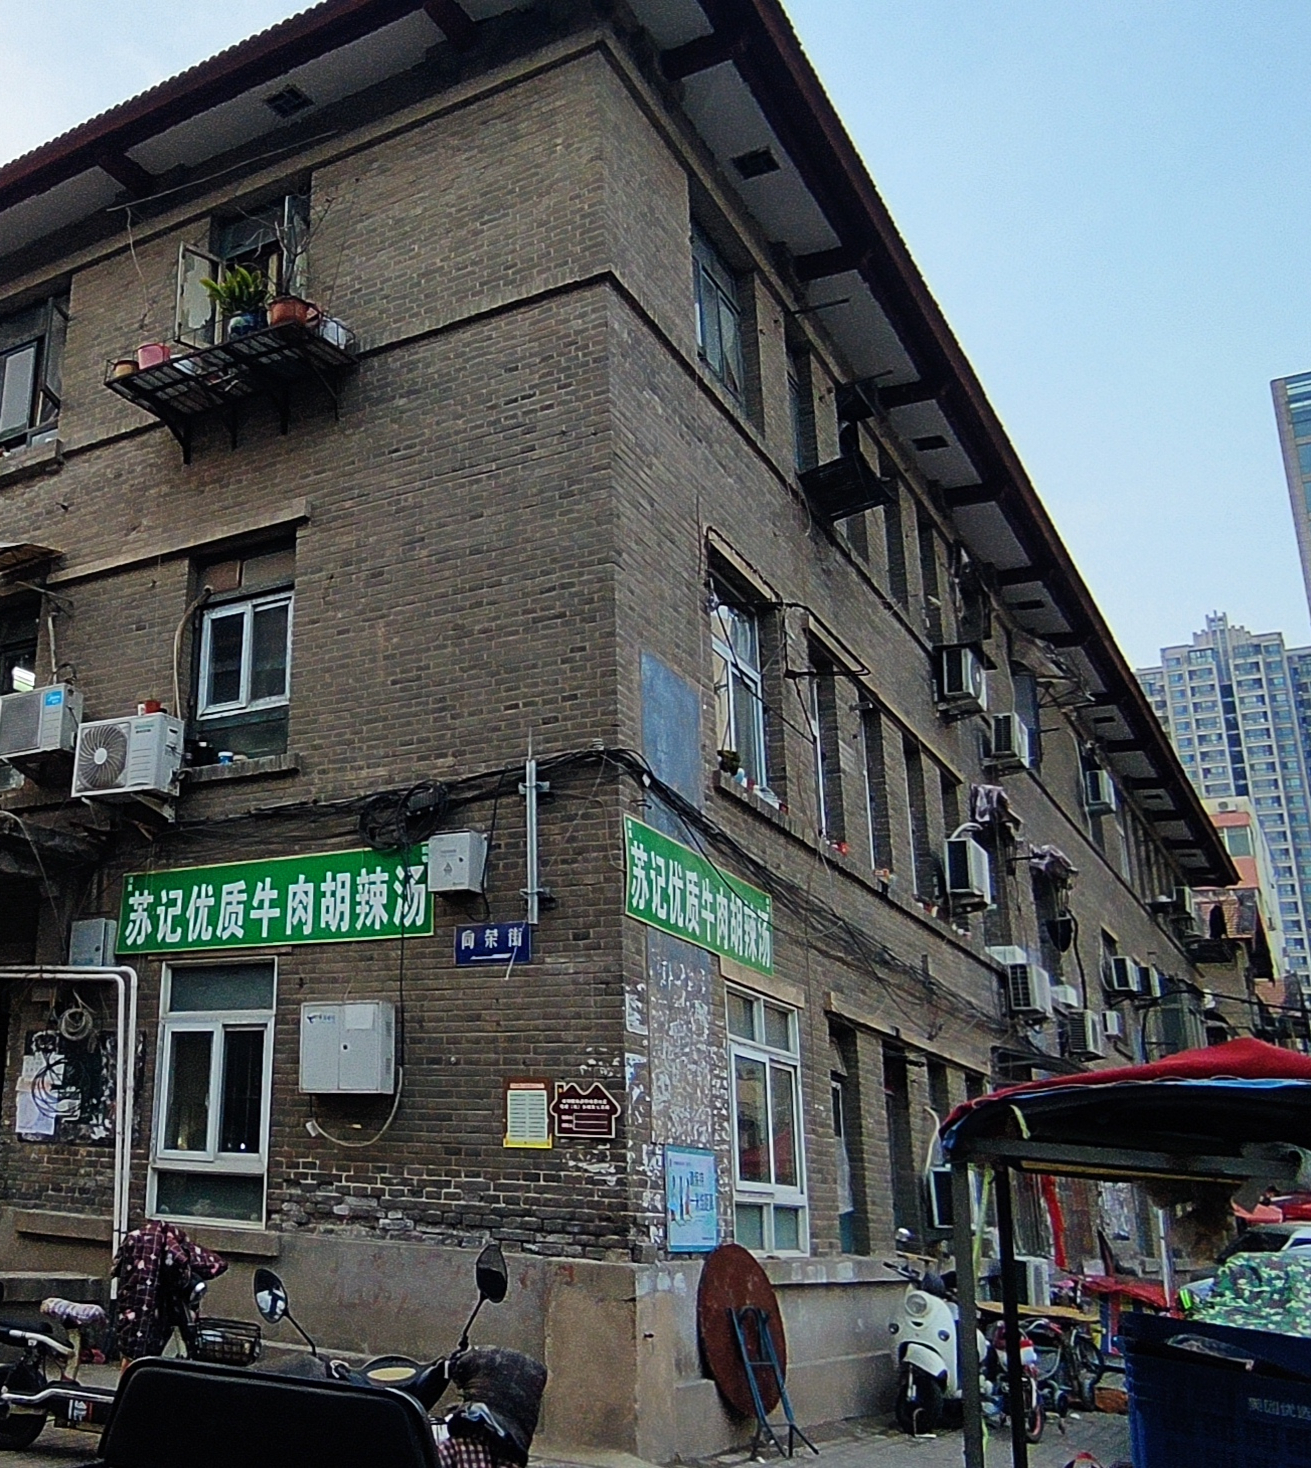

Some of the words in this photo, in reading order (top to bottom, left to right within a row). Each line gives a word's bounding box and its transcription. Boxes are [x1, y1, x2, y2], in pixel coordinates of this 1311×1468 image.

[124, 865, 427, 946] 苏记优质牛肉胡辣汤
[461, 927, 523, 950] 向荣街
[631, 840, 771, 968] 苏记优质牛肉胡辣汤
